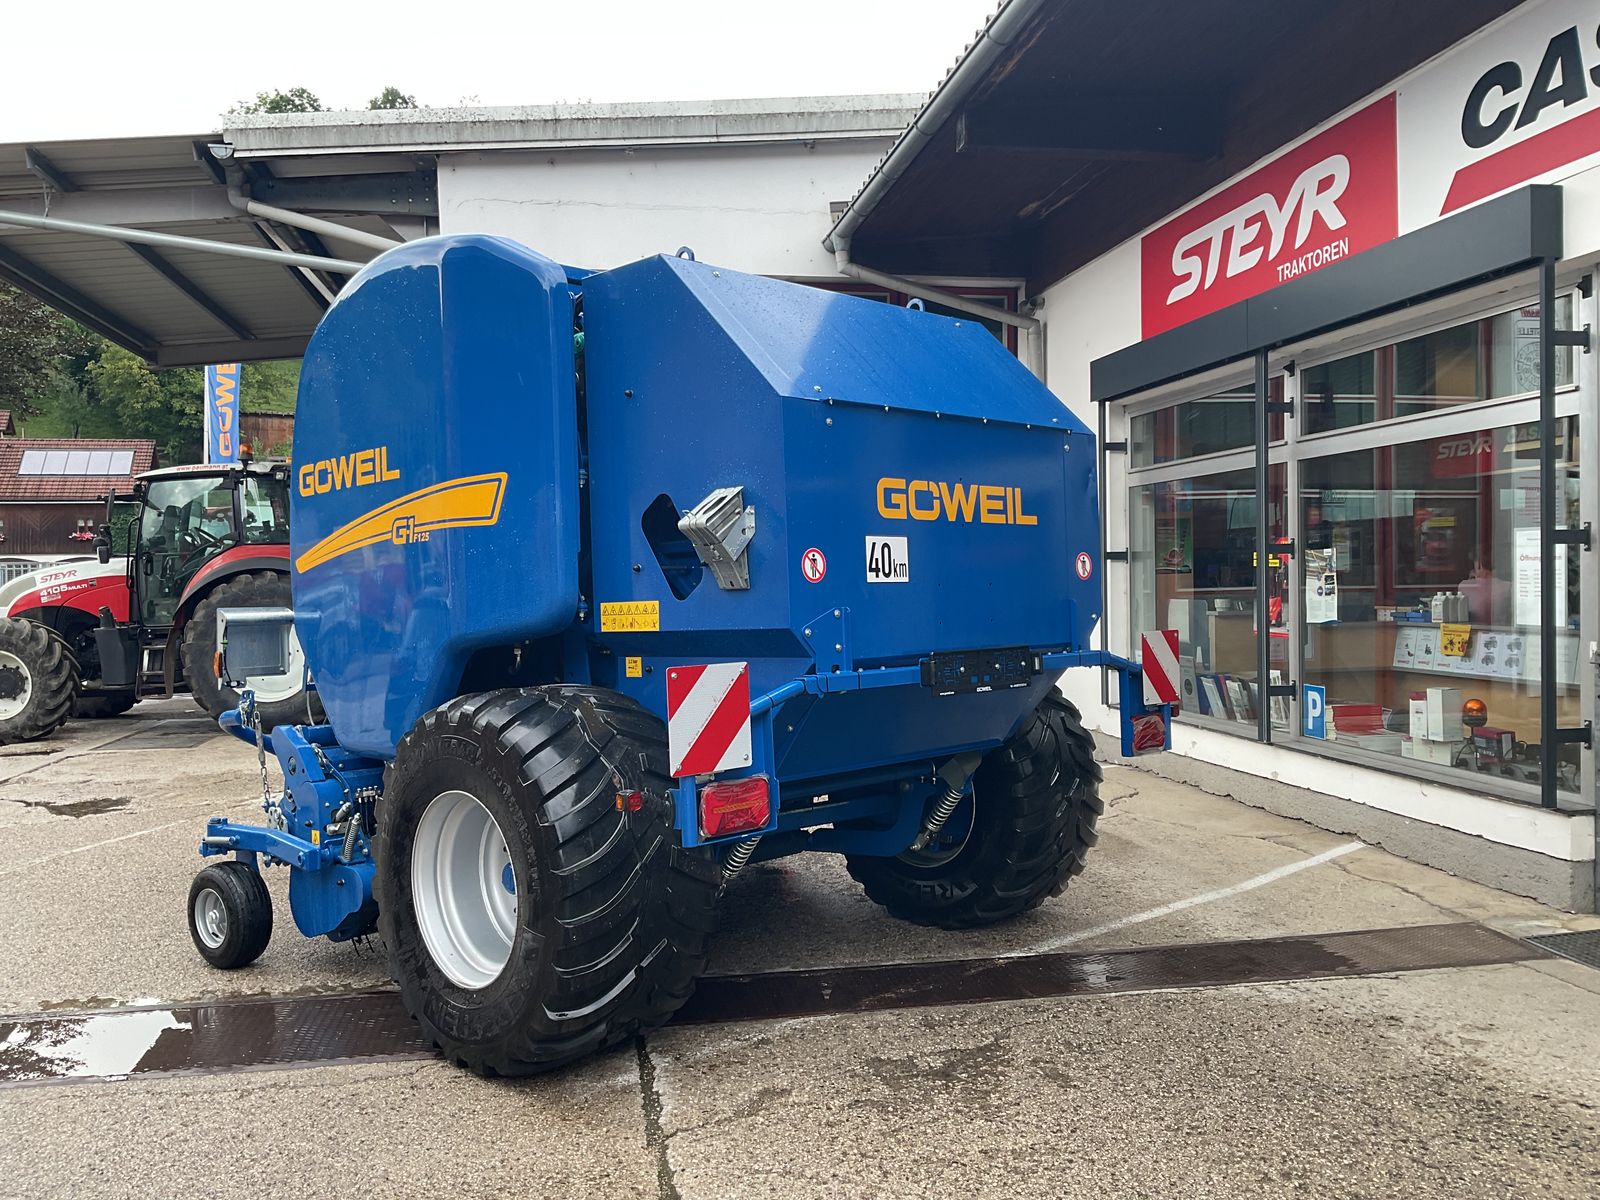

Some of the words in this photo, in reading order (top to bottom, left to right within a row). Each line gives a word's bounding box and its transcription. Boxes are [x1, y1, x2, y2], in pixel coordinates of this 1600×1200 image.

[1462, 23, 1600, 149] CA
[1166, 154, 1351, 306] STEYR
[1277, 237, 1350, 283] TRAKTOREN
[1436, 436, 1492, 460] STEYR
[414, 532, 430, 543] F125
[40, 569, 77, 583] STEYR
[1307, 690, 1322, 730] P
